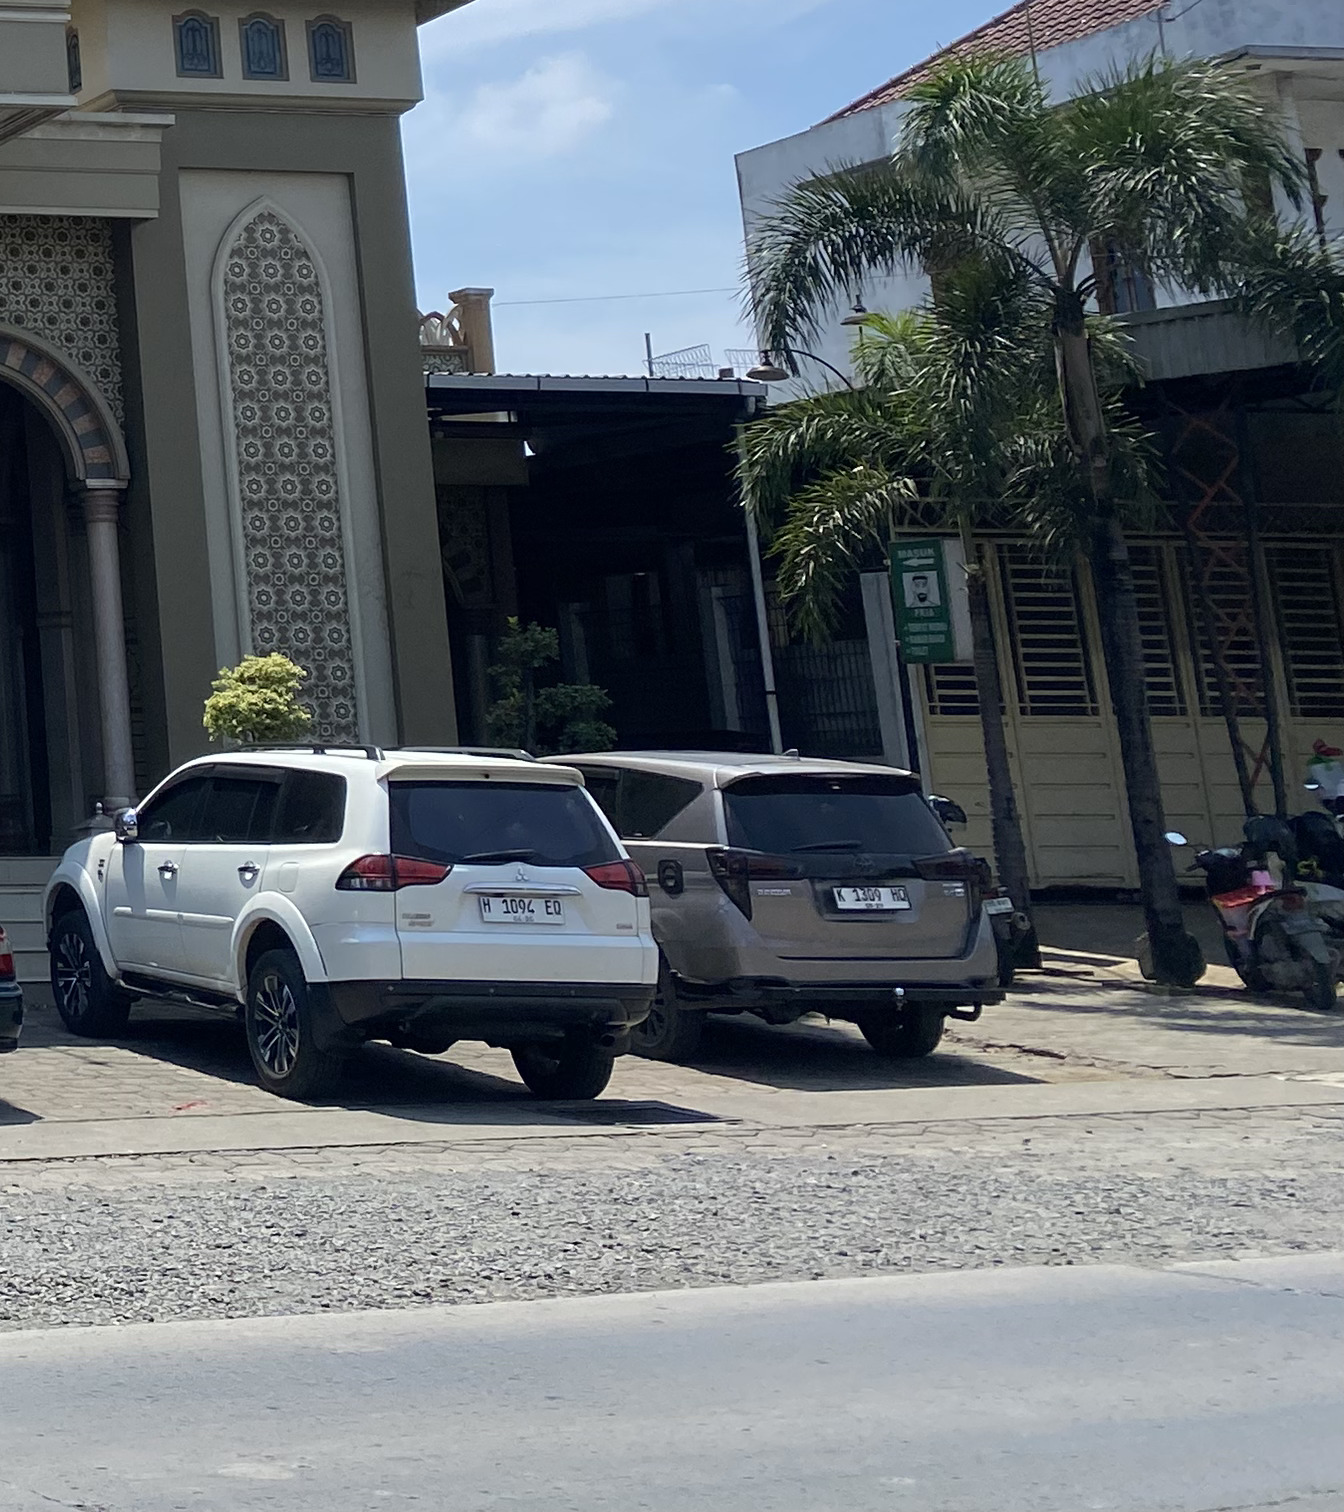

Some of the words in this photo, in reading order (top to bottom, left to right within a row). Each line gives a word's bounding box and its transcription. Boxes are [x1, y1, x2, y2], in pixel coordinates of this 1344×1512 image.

[836, 888, 846, 901] K
[852, 888, 882, 902] 1309
[482, 898, 491, 913] H
[502, 898, 535, 914] 1094
[544, 900, 562, 915] EQ
